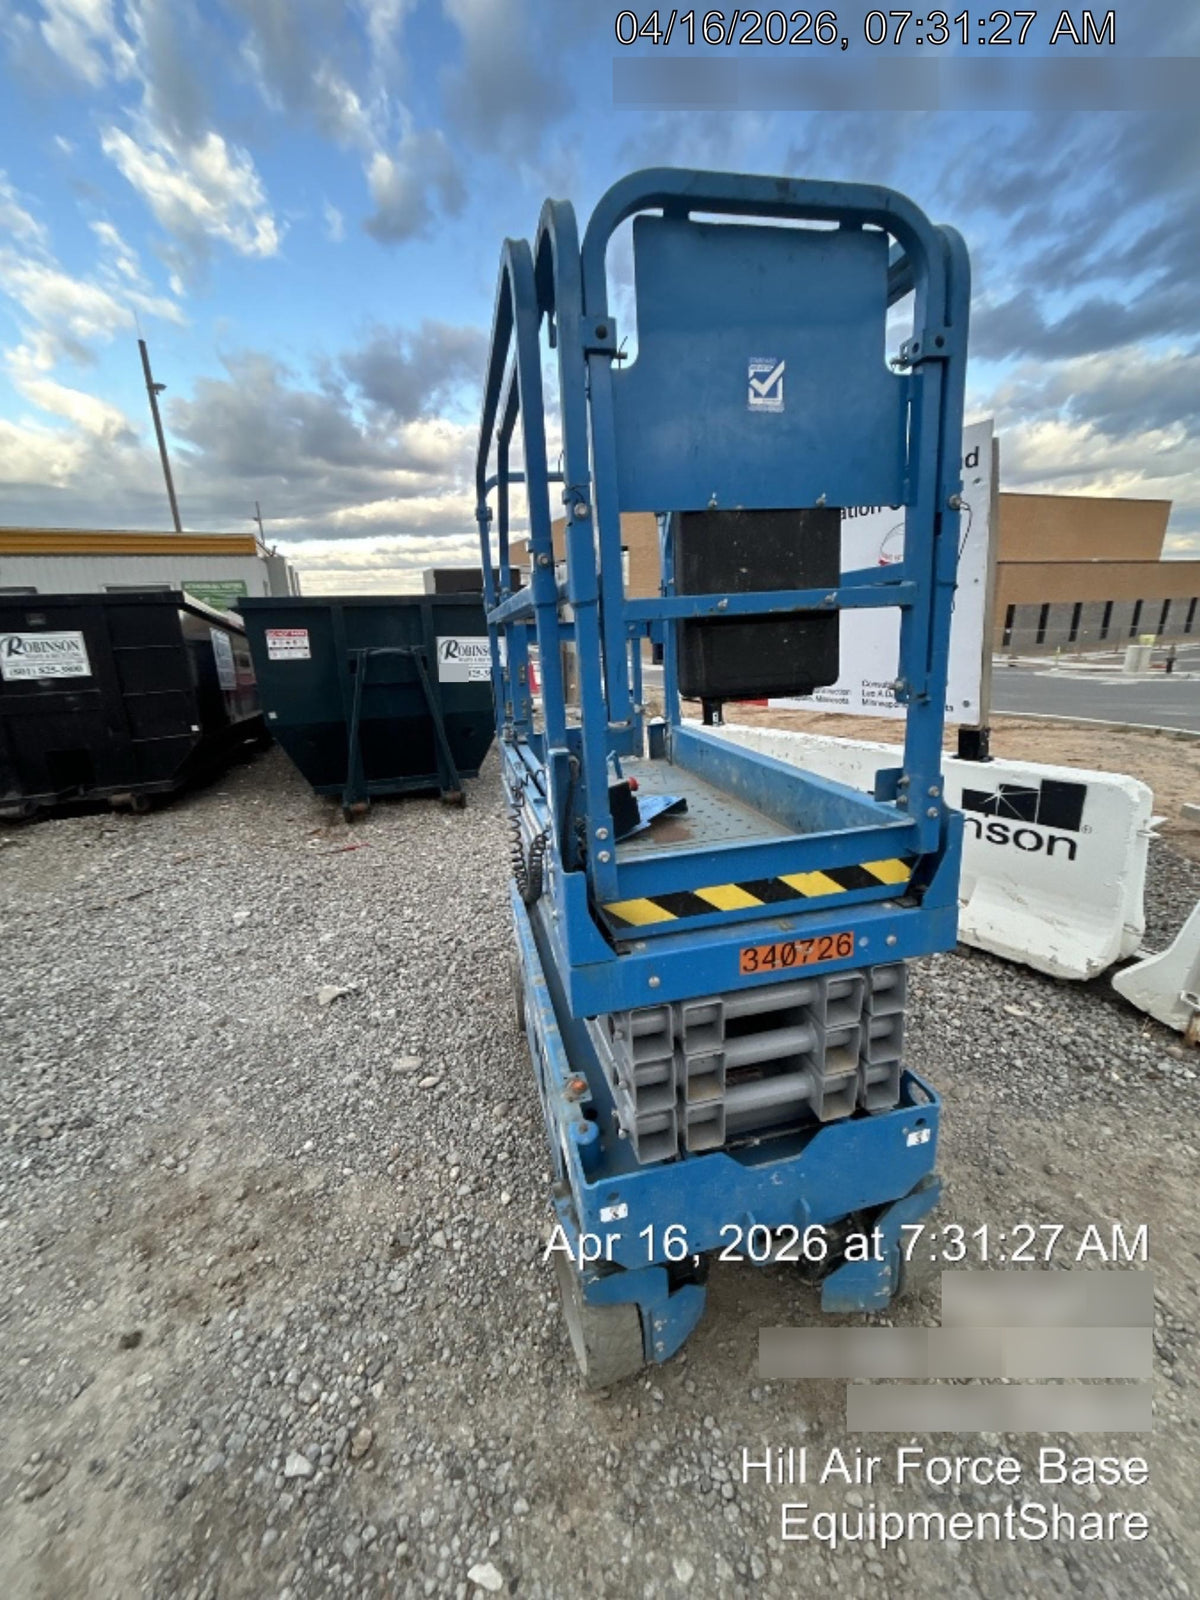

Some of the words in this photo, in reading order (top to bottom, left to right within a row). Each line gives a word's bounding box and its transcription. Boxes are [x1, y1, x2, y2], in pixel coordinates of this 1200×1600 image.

[0, 636, 80, 657] ROBINSON
[440, 640, 489, 659] ROBINS
[742, 932, 853, 972] 340726
